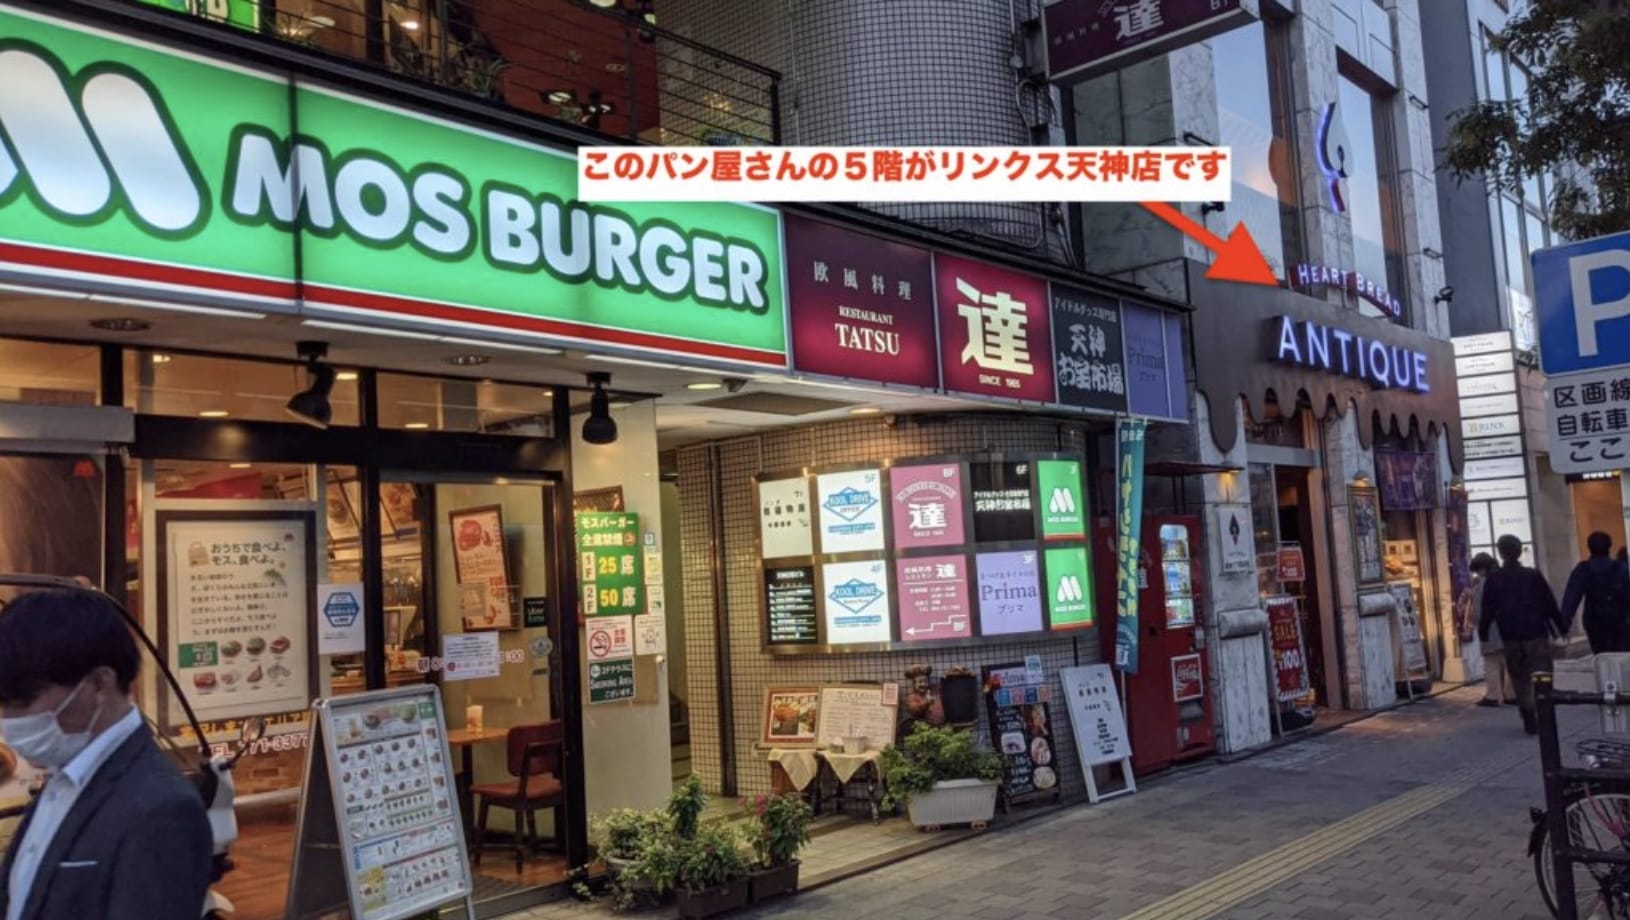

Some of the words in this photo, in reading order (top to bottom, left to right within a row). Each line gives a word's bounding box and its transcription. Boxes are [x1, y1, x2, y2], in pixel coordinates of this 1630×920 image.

[230, 131, 472, 255] MOS
[485, 188, 768, 310] BURGER
[813, 260, 912, 300] 欧風料理
[1297, 263, 1348, 286] HEART
[1355, 273, 1401, 317] BREAD
[838, 305, 893, 325] RESTAURANT
[1568, 249, 1630, 357] P
[834, 322, 900, 355] TATSU
[956, 277, 1034, 375] 達
[1069, 324, 1106, 356] 天神
[1278, 314, 1431, 393] ANTIQUE
[1058, 352, 1124, 395] お宝市場
[1557, 407, 1629, 437] 自転車
[581, 516, 635, 529] モスバーガー
[907, 503, 947, 529] 達
[599, 556, 617, 574] 25
[600, 588, 618, 607] 50
[981, 582, 1037, 601] Prima
